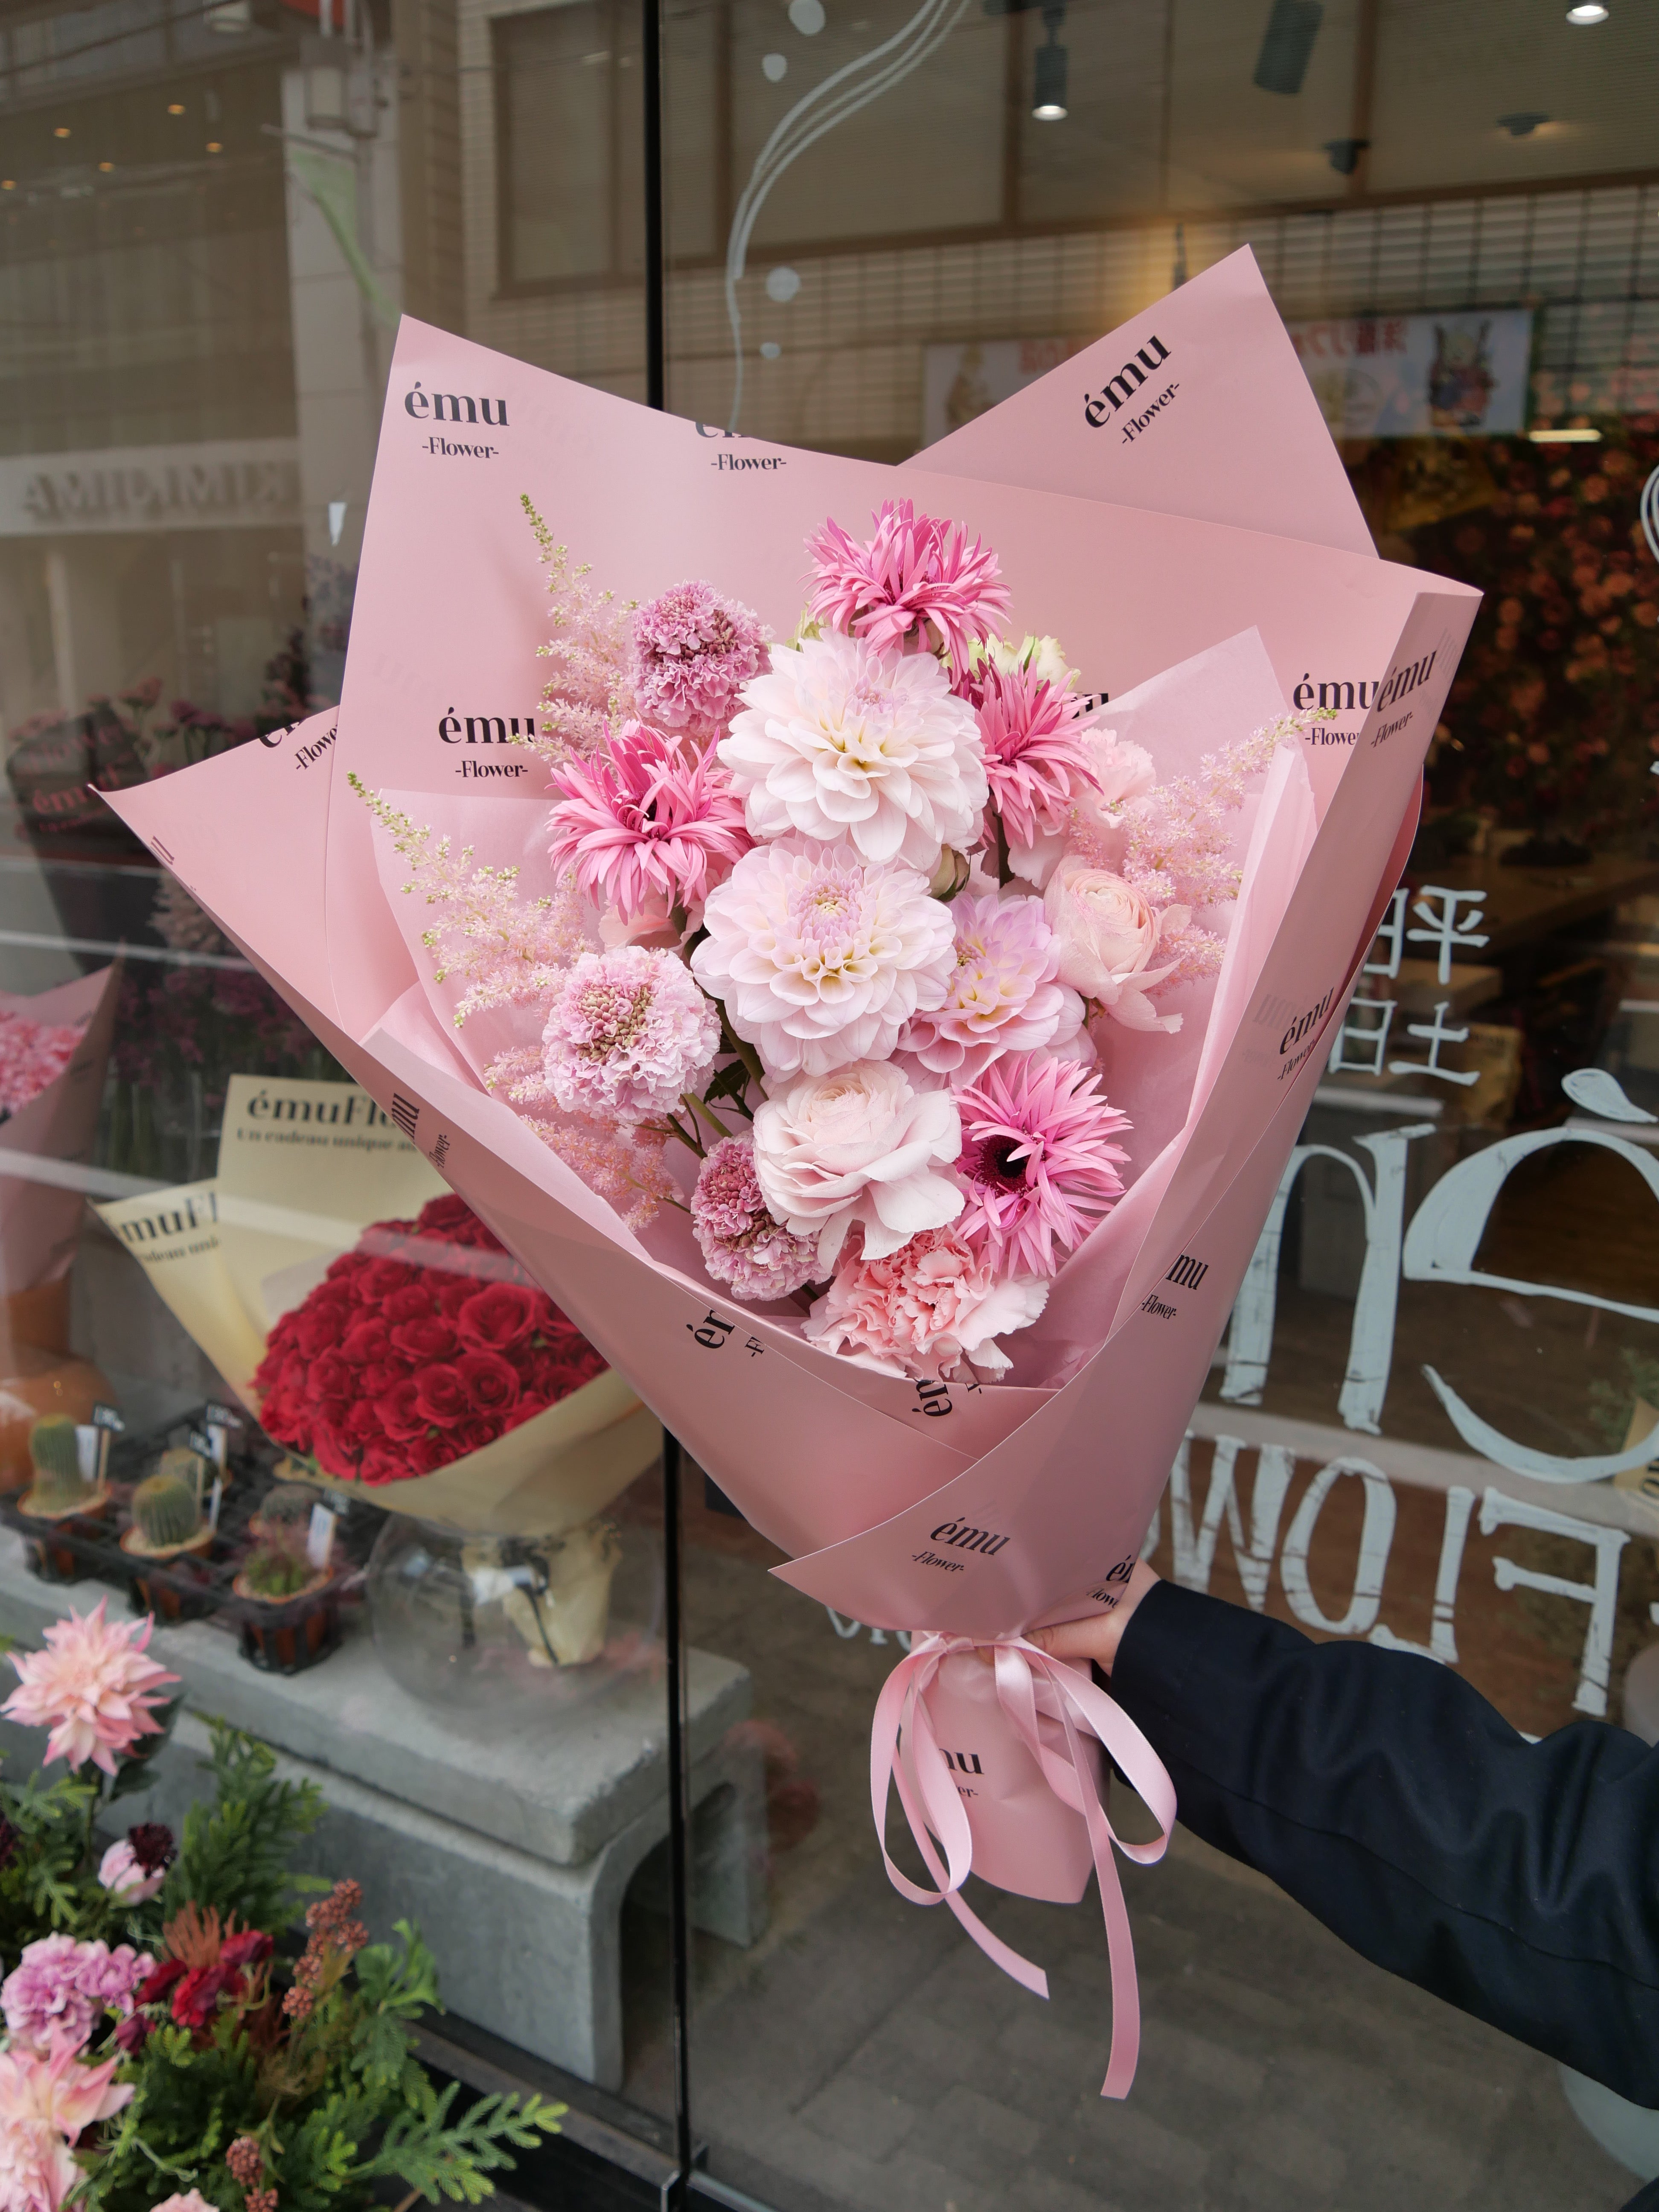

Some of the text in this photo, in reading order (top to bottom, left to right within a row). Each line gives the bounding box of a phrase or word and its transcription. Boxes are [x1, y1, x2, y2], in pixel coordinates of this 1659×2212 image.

[1084, 335, 1171, 428] ému
[404, 381, 510, 426] ému
[1121, 384, 1179, 444] -Flower-
[422, 437, 499, 459] -Flower-
[711, 454, 786, 470] -Flower-
[1293, 672, 1380, 710] ému
[1377, 649, 1437, 712] ému
[439, 707, 538, 744] ému
[1305, 728, 1359, 745] -Flowe
[1371, 711, 1413, 748] -Flower-
[294, 724, 338, 770] -Flowe
[455, 760, 528, 778] -Flower-
[1280, 987, 1334, 1055] ému
[391, 1093, 419, 1144] mu
[1165, 1254, 1209, 1290] mu
[1141, 1294, 1177, 1319] -Flower-
[930, 1517, 1011, 1555] ému
[911, 1551, 964, 1572] -Flower-
